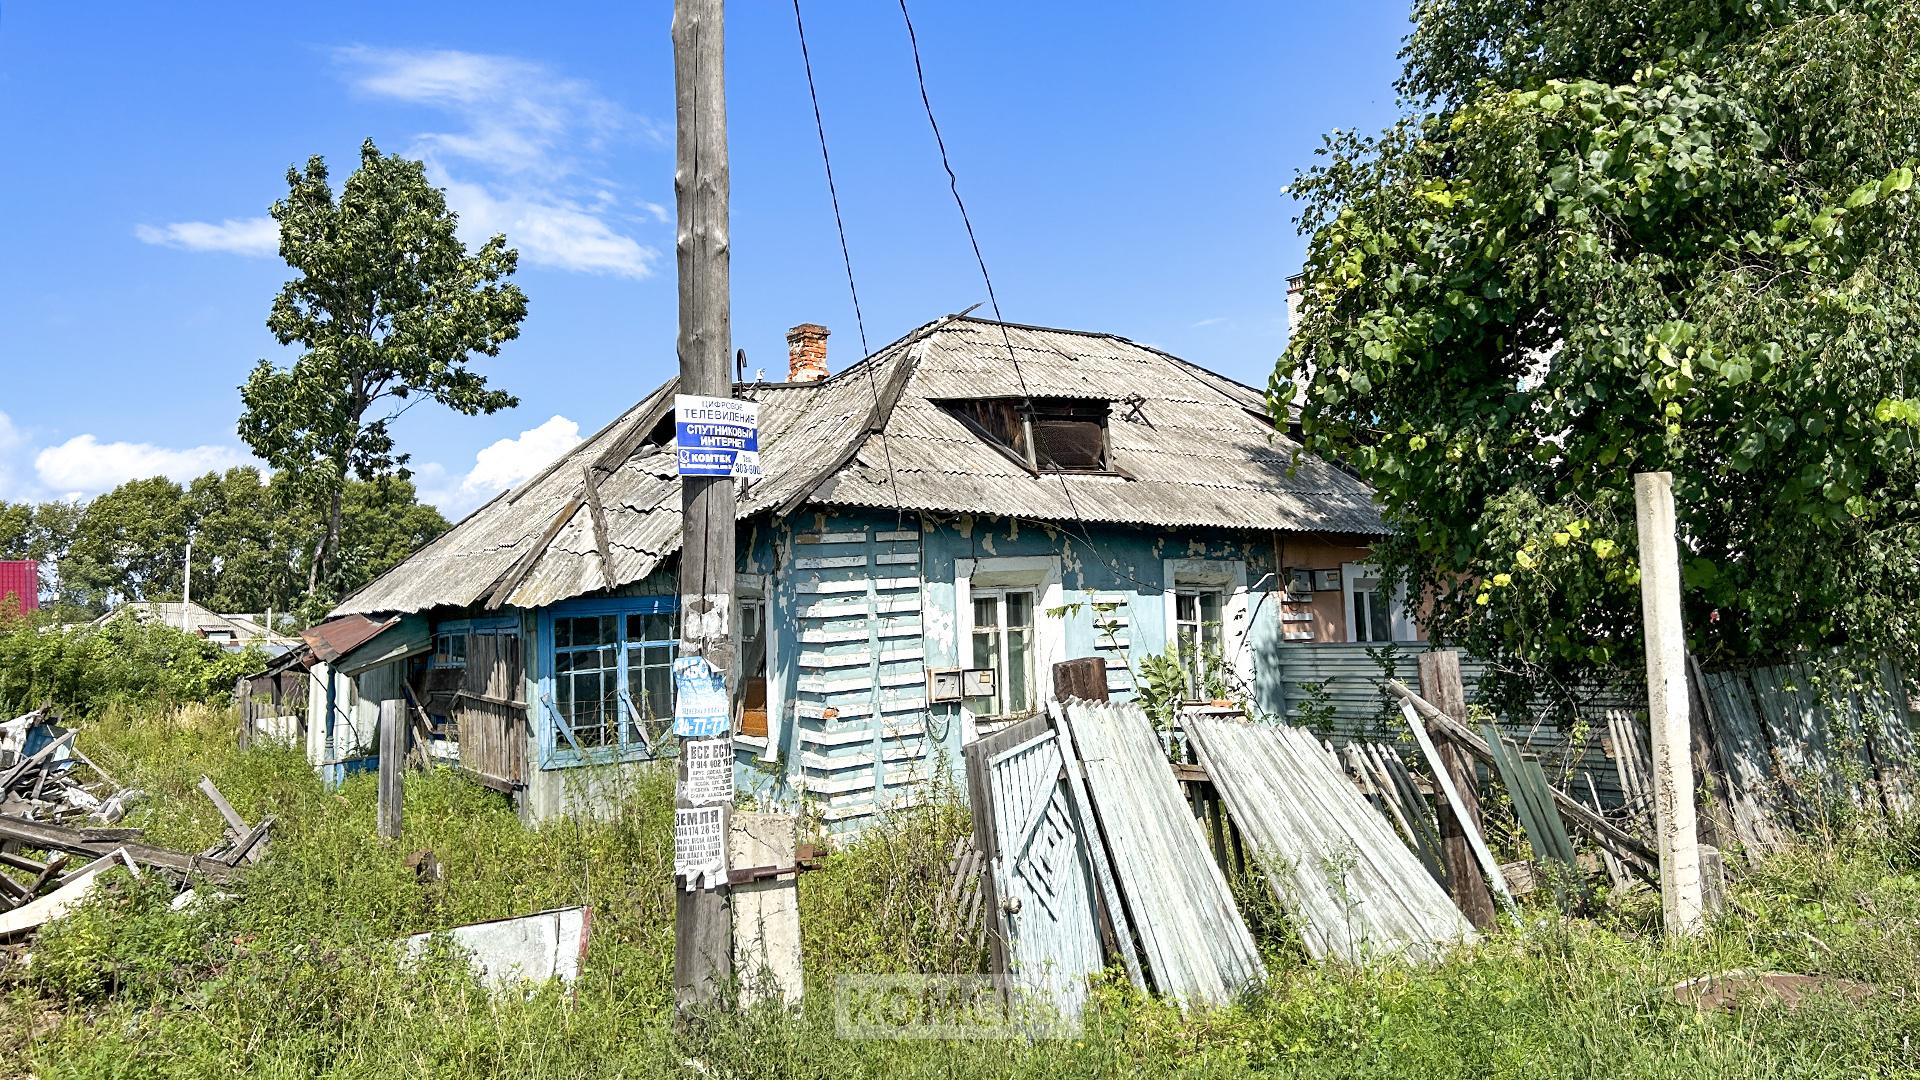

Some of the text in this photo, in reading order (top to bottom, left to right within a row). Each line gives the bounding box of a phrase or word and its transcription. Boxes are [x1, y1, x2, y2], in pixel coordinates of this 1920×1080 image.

[701, 400, 743, 411] ЦИФРОВОЕ
[684, 408, 755, 424] ТЕЛЕВИДЕНИЕ
[686, 424, 754, 439] СПУТНИКОВЫЙ
[700, 436, 746, 449] ИНТЕРНЕТ
[691, 453, 732, 463] КОМТЕК
[690, 745, 710, 760] ВСЕ
[695, 760, 708, 769] 914
[675, 809, 719, 826] ЗЕМЛЯ
[688, 826, 699, 836] 174
[700, 825, 710, 835] 28
[711, 823, 720, 834] 59
